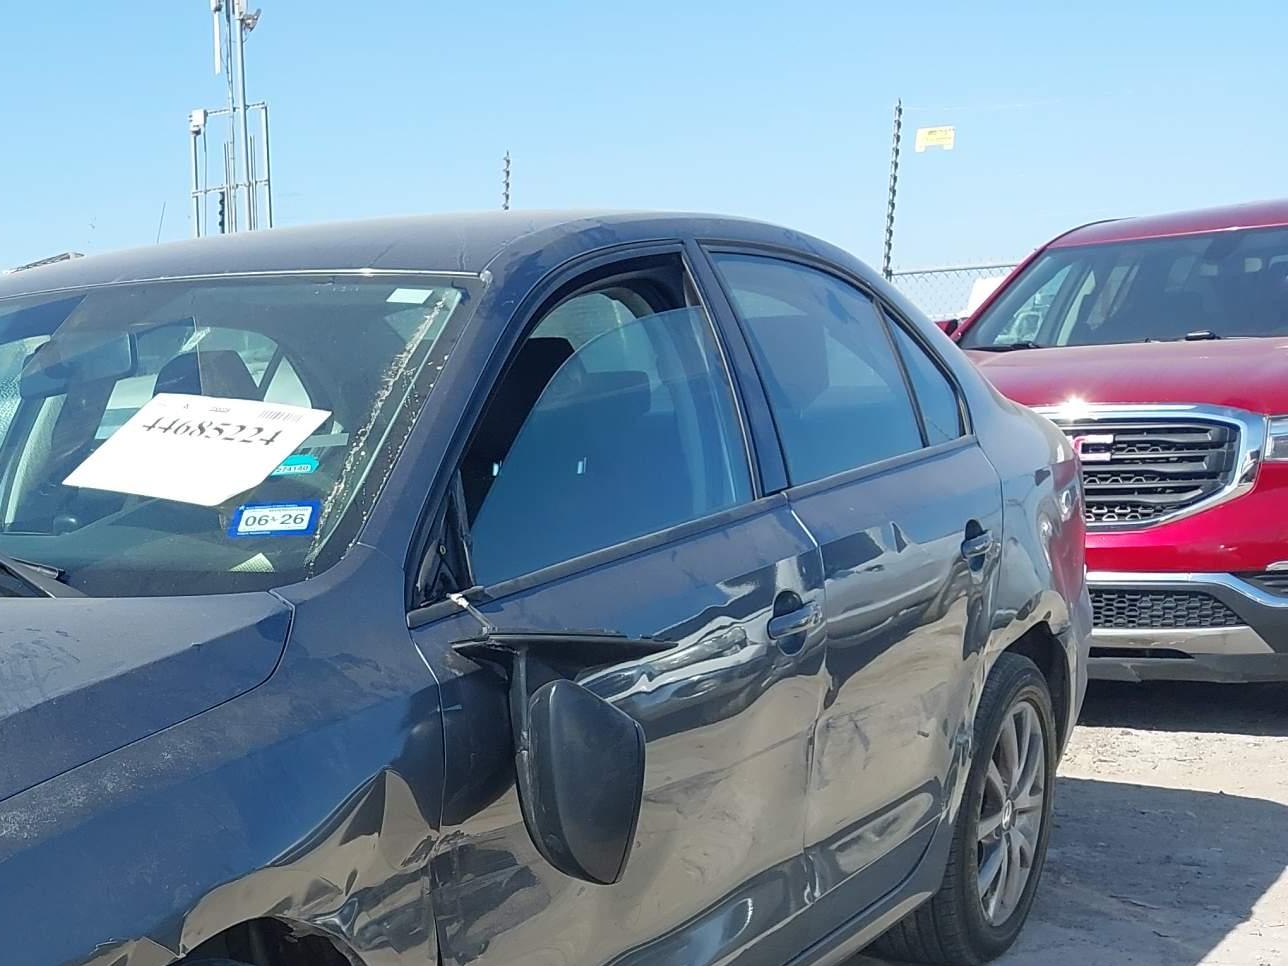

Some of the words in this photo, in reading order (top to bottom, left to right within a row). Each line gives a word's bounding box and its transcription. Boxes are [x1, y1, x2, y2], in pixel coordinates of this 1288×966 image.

[142, 416, 283, 446] 44685224
[244, 514, 271, 527] 06
[279, 513, 306, 525] 26
